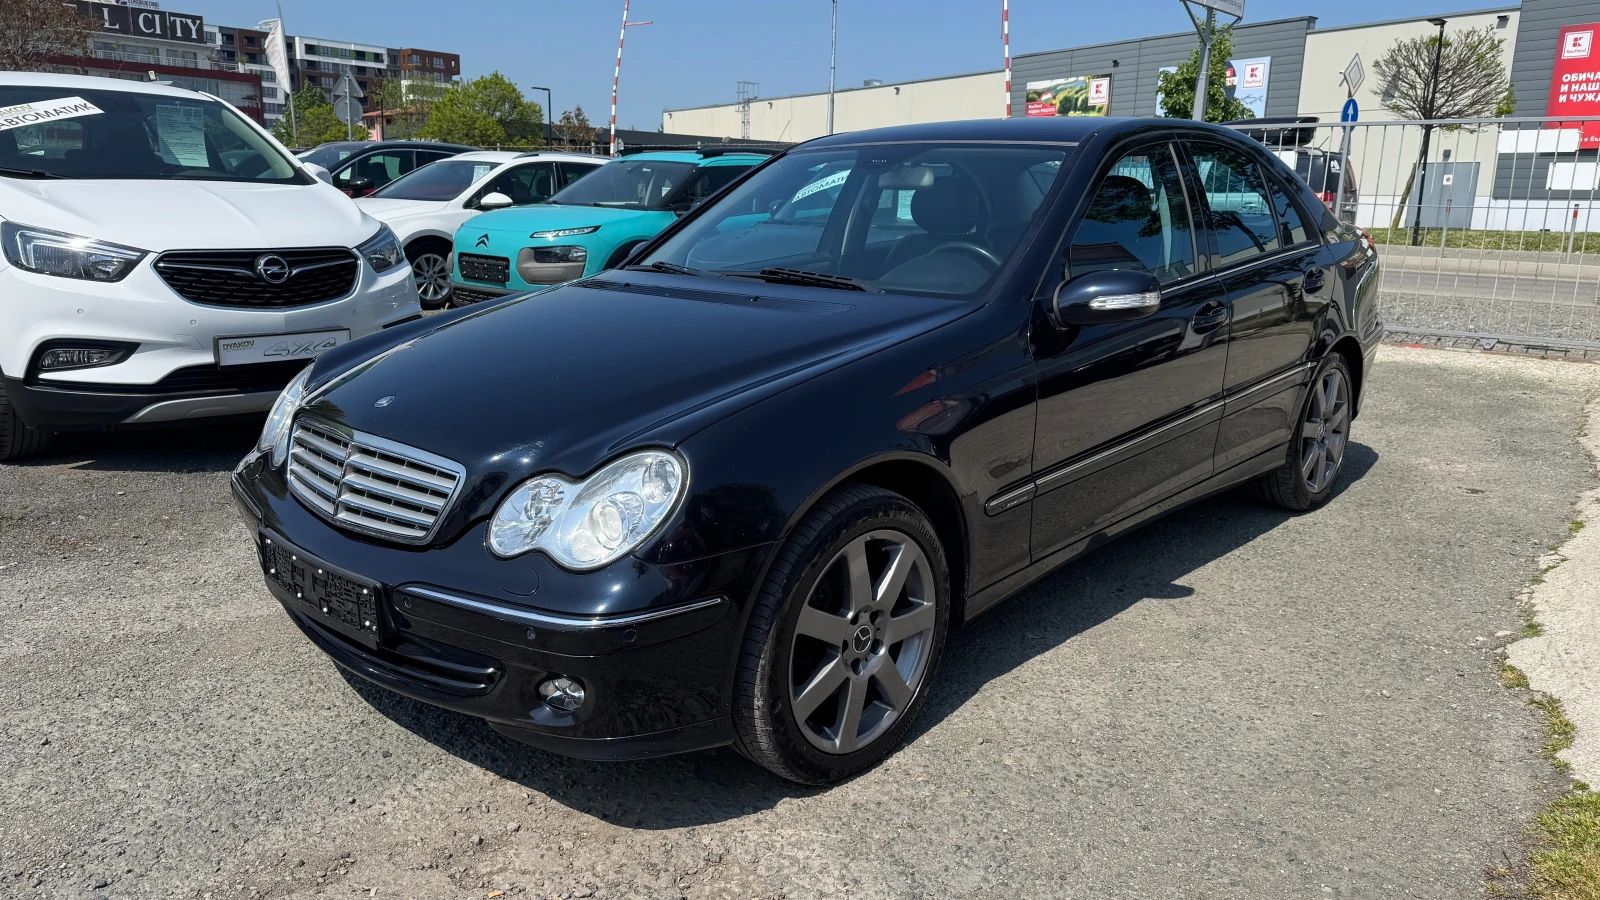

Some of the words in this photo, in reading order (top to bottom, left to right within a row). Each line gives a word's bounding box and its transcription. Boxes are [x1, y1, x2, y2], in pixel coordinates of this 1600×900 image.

[138, 12, 200, 39] CITY
[1560, 83, 1569, 93] И
[1558, 94, 1568, 103] И
[222, 340, 255, 350] DYAKOV
